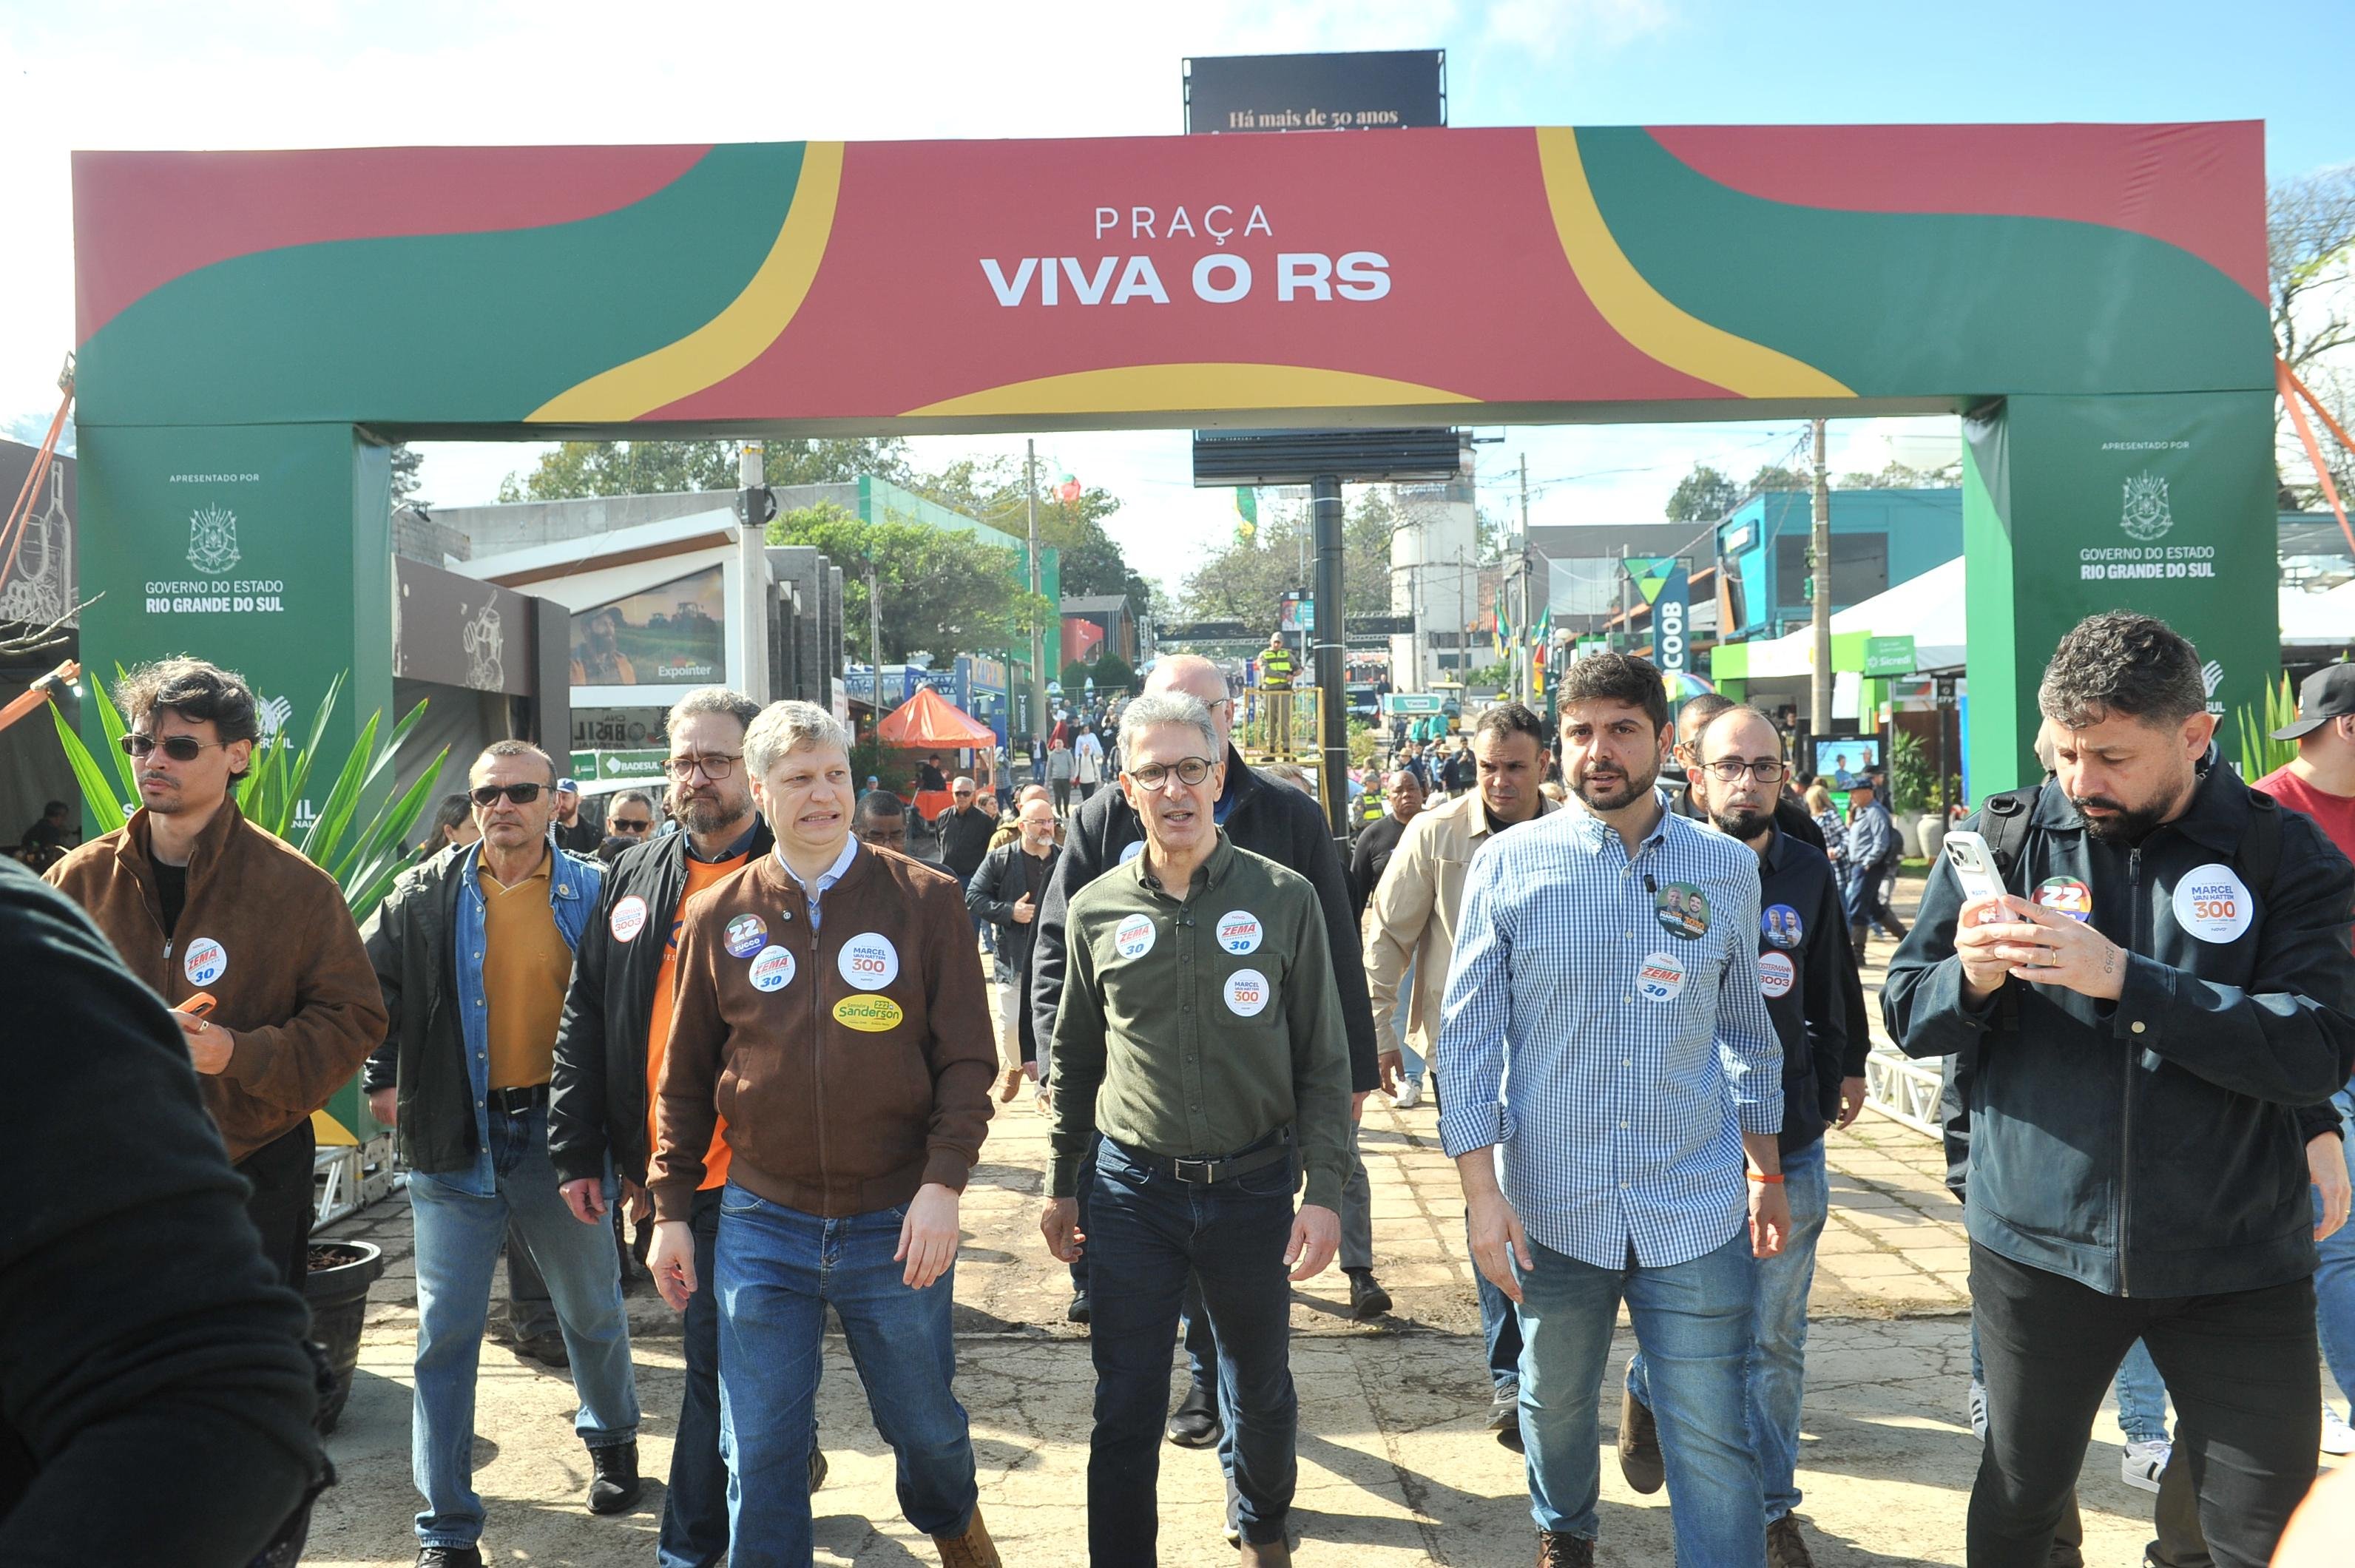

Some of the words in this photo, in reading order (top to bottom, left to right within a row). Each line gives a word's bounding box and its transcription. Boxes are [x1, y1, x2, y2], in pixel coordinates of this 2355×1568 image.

[1229, 109, 1254, 127] Há
[1259, 109, 1301, 127] mais
[1305, 109, 1327, 126] de
[1331, 112, 1352, 126] 50
[1356, 110, 1399, 124] anos
[1095, 205, 1273, 246] PRAÇA
[979, 256, 1170, 306] VIVA
[1192, 253, 1252, 303] O
[1277, 251, 1391, 302] RS
[2101, 442, 2169, 450] APRESENTADO
[2170, 441, 2189, 449] POR
[169, 474, 237, 482] APRESENTADO
[240, 473, 260, 481] POR
[2080, 547, 2142, 561] GOVERNO
[2145, 547, 2163, 559] DO
[2166, 546, 2214, 559] ESTADO
[2081, 564, 2106, 580] RIO
[2108, 564, 2164, 579] GRANDE
[2166, 563, 2186, 578] DO
[2188, 562, 2216, 578] SUL
[145, 581, 208, 594] GOVERNO
[212, 581, 230, 593] DO
[234, 580, 284, 592] ESTADO
[146, 598, 171, 613] RIO
[172, 597, 232, 612] GRANDE
[233, 597, 254, 612] DO
[256, 596, 285, 612] SUL
[1662, 601, 1683, 675] ICOOB
[658, 664, 712, 679] Expointer
[621, 761, 660, 771] BADESUL
[2040, 885, 2083, 910] 22
[2192, 885, 2234, 895] MARCEL
[2194, 900, 2235, 919] 300
[615, 918, 642, 932] 3003
[729, 919, 760, 943] 22
[1222, 922, 1256, 936] ZEMA
[1120, 925, 1149, 943] ZEMA
[734, 938, 761, 953] ZUCCO
[853, 947, 886, 956] MARCEL
[1126, 943, 1145, 955] 30
[1229, 940, 1251, 950] 30
[188, 948, 217, 971] ZEMA
[756, 957, 788, 974] ZEMA
[852, 959, 885, 973] 300
[195, 967, 214, 983] 30
[760, 975, 783, 988] 30
[1641, 967, 1681, 982] ZEMA
[1234, 991, 1259, 1002] 300
[1643, 984, 1668, 997] 30
[839, 1006, 900, 1020] Sanderson
